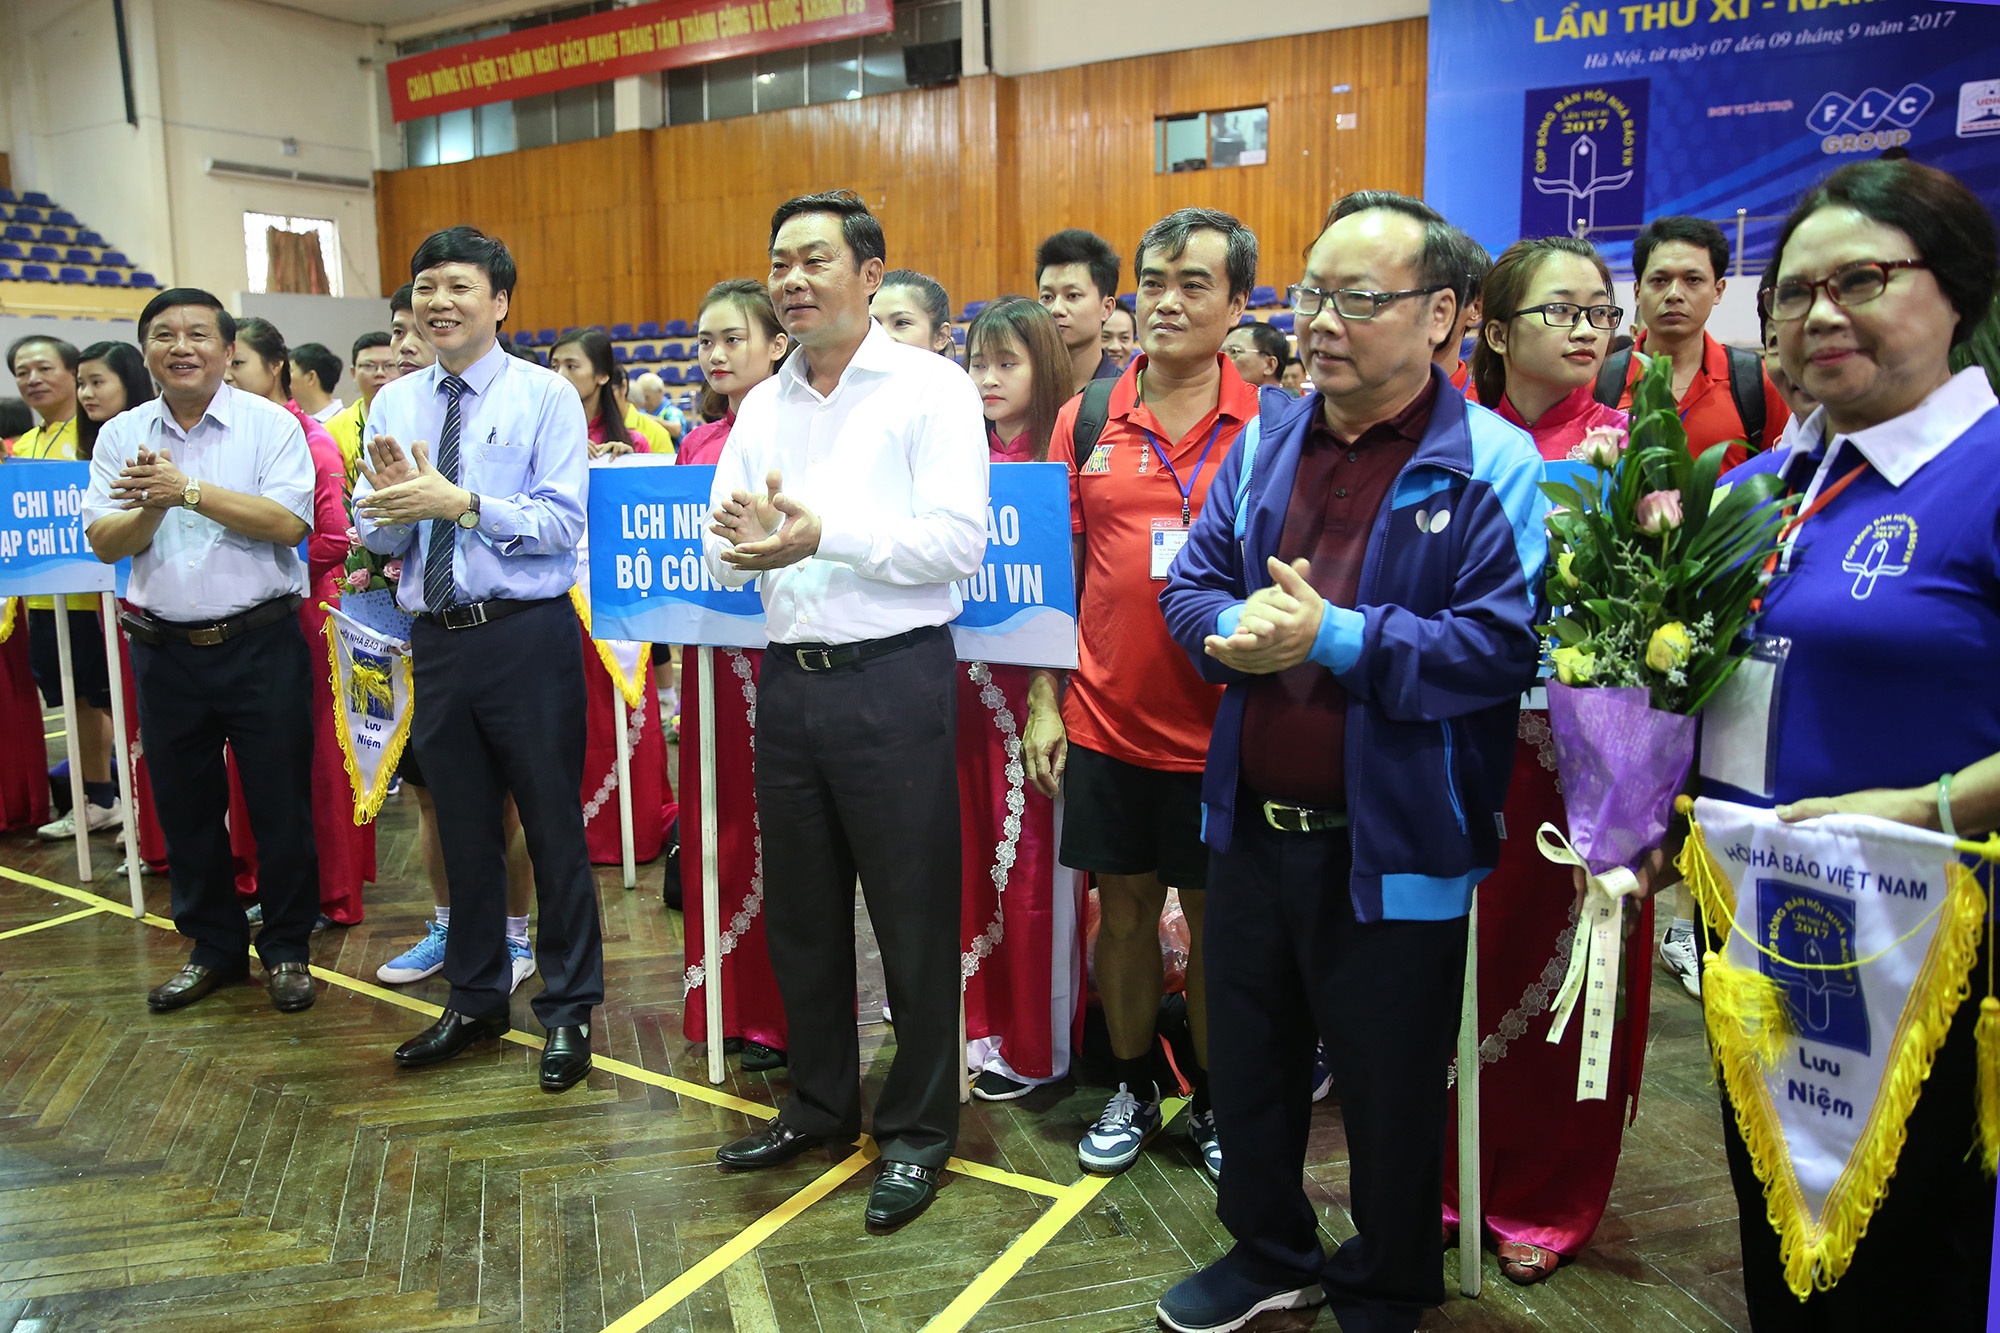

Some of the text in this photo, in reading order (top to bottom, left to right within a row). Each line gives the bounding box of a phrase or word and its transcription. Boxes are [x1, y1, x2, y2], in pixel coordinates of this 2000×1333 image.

[1534, 2, 1608, 43] LẦN
[1708, 0, 1750, 23] XI
[1584, 52, 1608, 69] Hà
[1709, 37, 1733, 56] 07
[1768, 30, 1792, 49] 09
[1794, 26, 1845, 45] tháng
[1848, 22, 1861, 39] 9
[1907, 10, 1957, 32] 2017
[1561, 118, 1609, 134] 2017
[1821, 129, 1911, 155] GROUP
[1138, 443, 1150, 473] Reebok
[13, 490, 48, 519] CHI
[621, 504, 707, 540] LCH NH
[985, 497, 1020, 546] ÁO
[26, 522, 56, 556] CHÍ
[59, 522, 79, 554] LÝ
[616, 547, 653, 598] BỘ
[1003, 564, 1044, 604] VN
[357, 734, 381, 749] Niệm
[1783, 854, 1820, 879] BÁO
[1826, 865, 1871, 893] VIỆT
[1877, 874, 1928, 900] NAM
[1794, 921, 1829, 939] 2017
[1799, 1046, 1840, 1077] Lưu
[1788, 1079, 1853, 1119] Niệm
